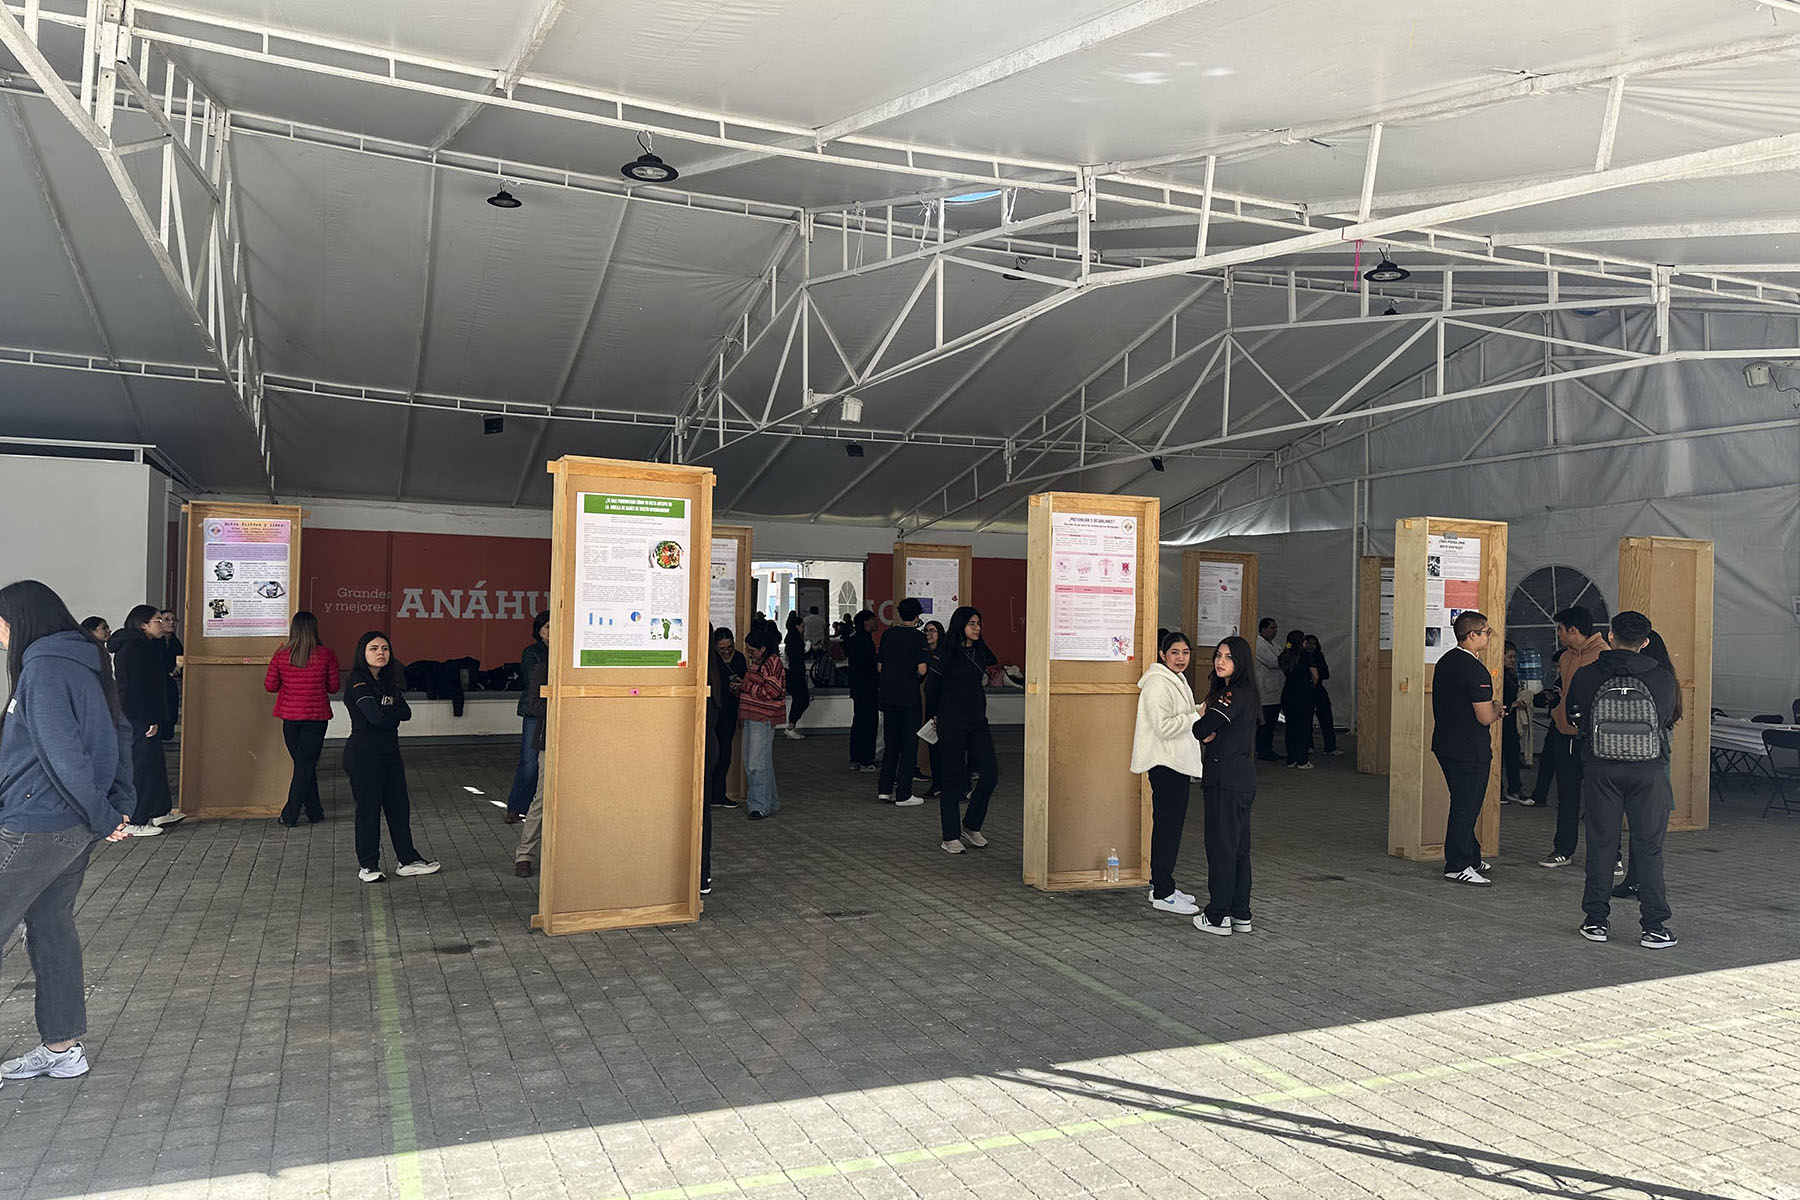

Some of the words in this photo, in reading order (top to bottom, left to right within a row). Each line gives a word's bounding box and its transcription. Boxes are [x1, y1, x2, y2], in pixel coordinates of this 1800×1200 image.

[336, 588, 392, 599] Grandes
[324, 602, 331, 613] y
[336, 602, 389, 613] mejores
